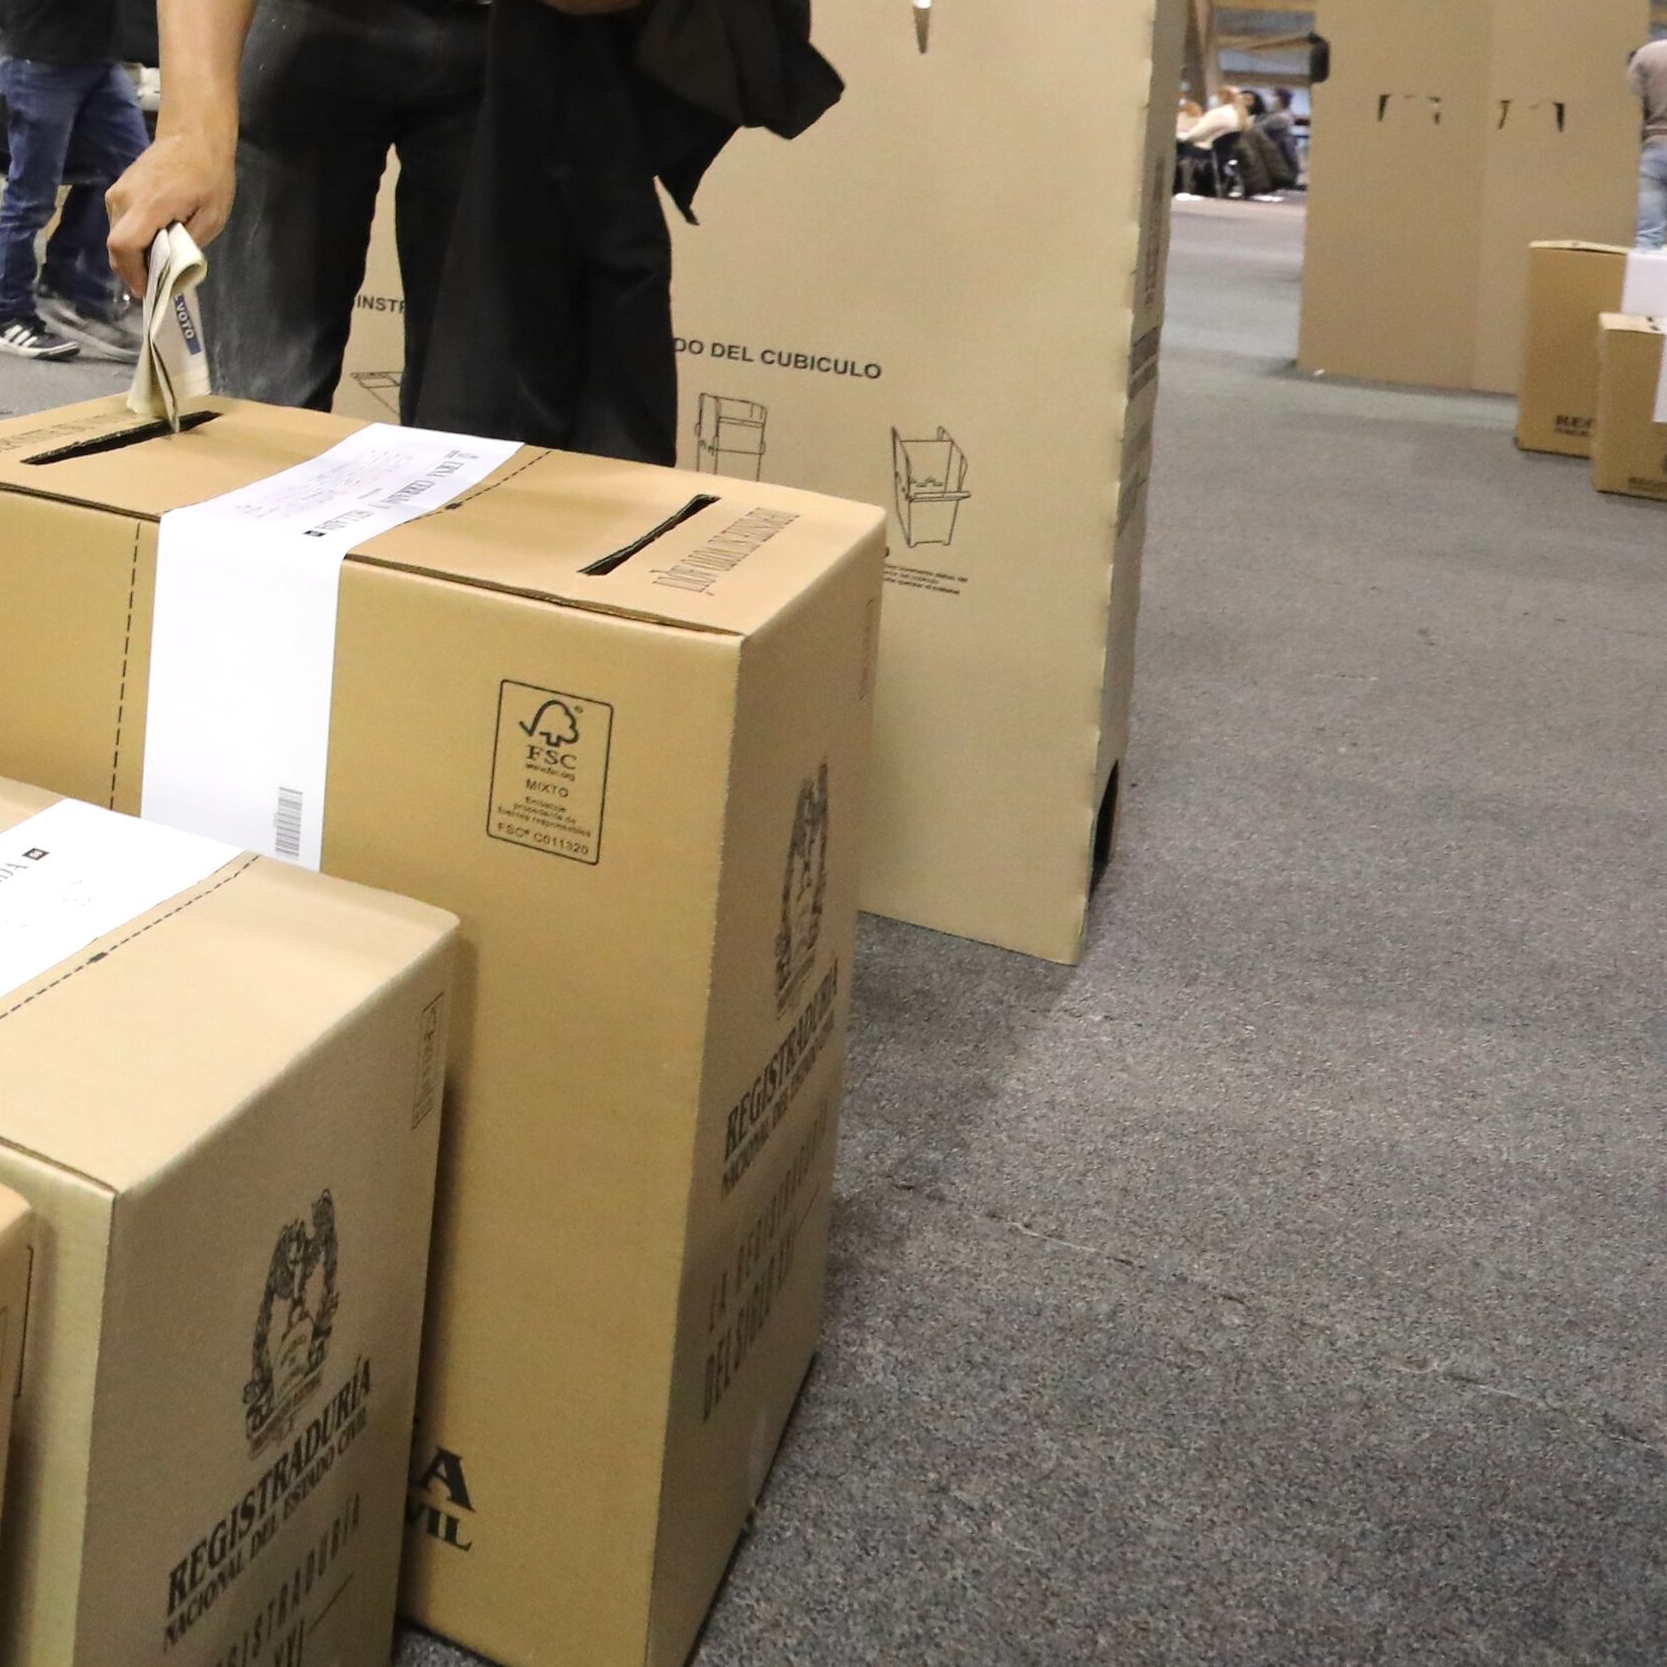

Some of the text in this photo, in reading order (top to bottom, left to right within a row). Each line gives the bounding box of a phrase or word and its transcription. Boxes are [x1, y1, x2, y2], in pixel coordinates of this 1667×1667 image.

[177, 302, 195, 339] VOTO
[711, 342, 755, 363] DEL
[761, 349, 882, 380] CUBICULO
[526, 744, 577, 770] FSC
[525, 778, 569, 799] MIXTO
[534, 832, 589, 855] C011320
[166, 1354, 371, 1617] REGISTRADURÍA
[163, 1552, 242, 1654] NACIONAL
[249, 1512, 276, 1561] DEL
[283, 1445, 335, 1521] ESTADO
